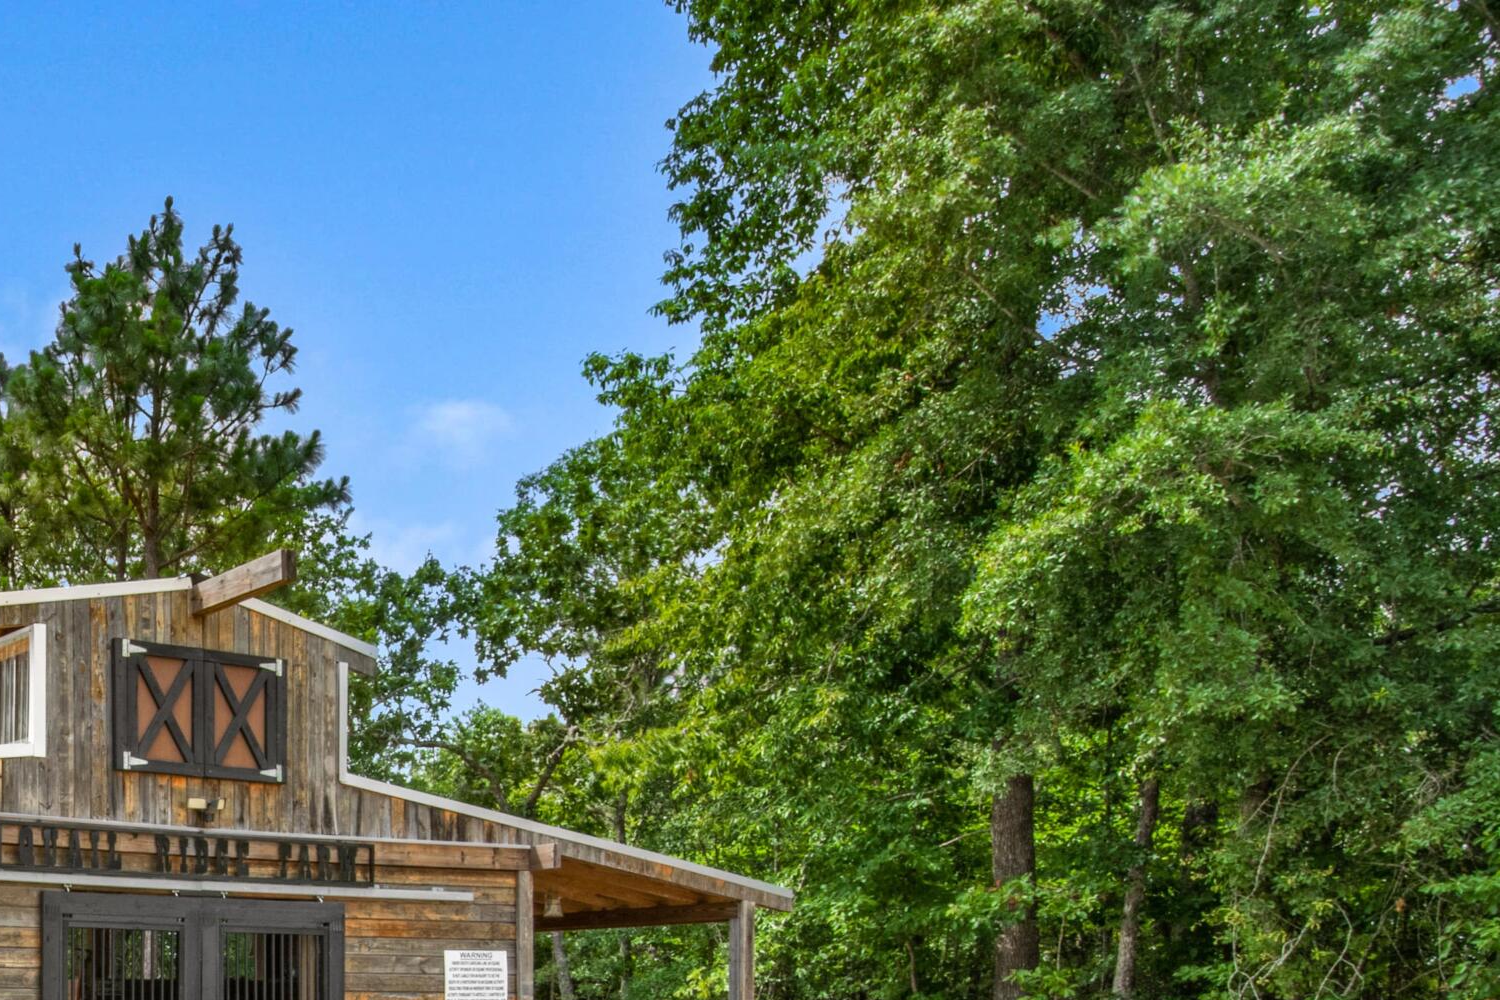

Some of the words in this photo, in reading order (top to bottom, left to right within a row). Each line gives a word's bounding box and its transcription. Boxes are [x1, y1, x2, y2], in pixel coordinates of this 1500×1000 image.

[18, 824, 122, 869] QUAIL
[156, 834, 250, 877] RIDGE
[277, 841, 357, 884] FARM
[459, 951, 493, 959] WARNING
